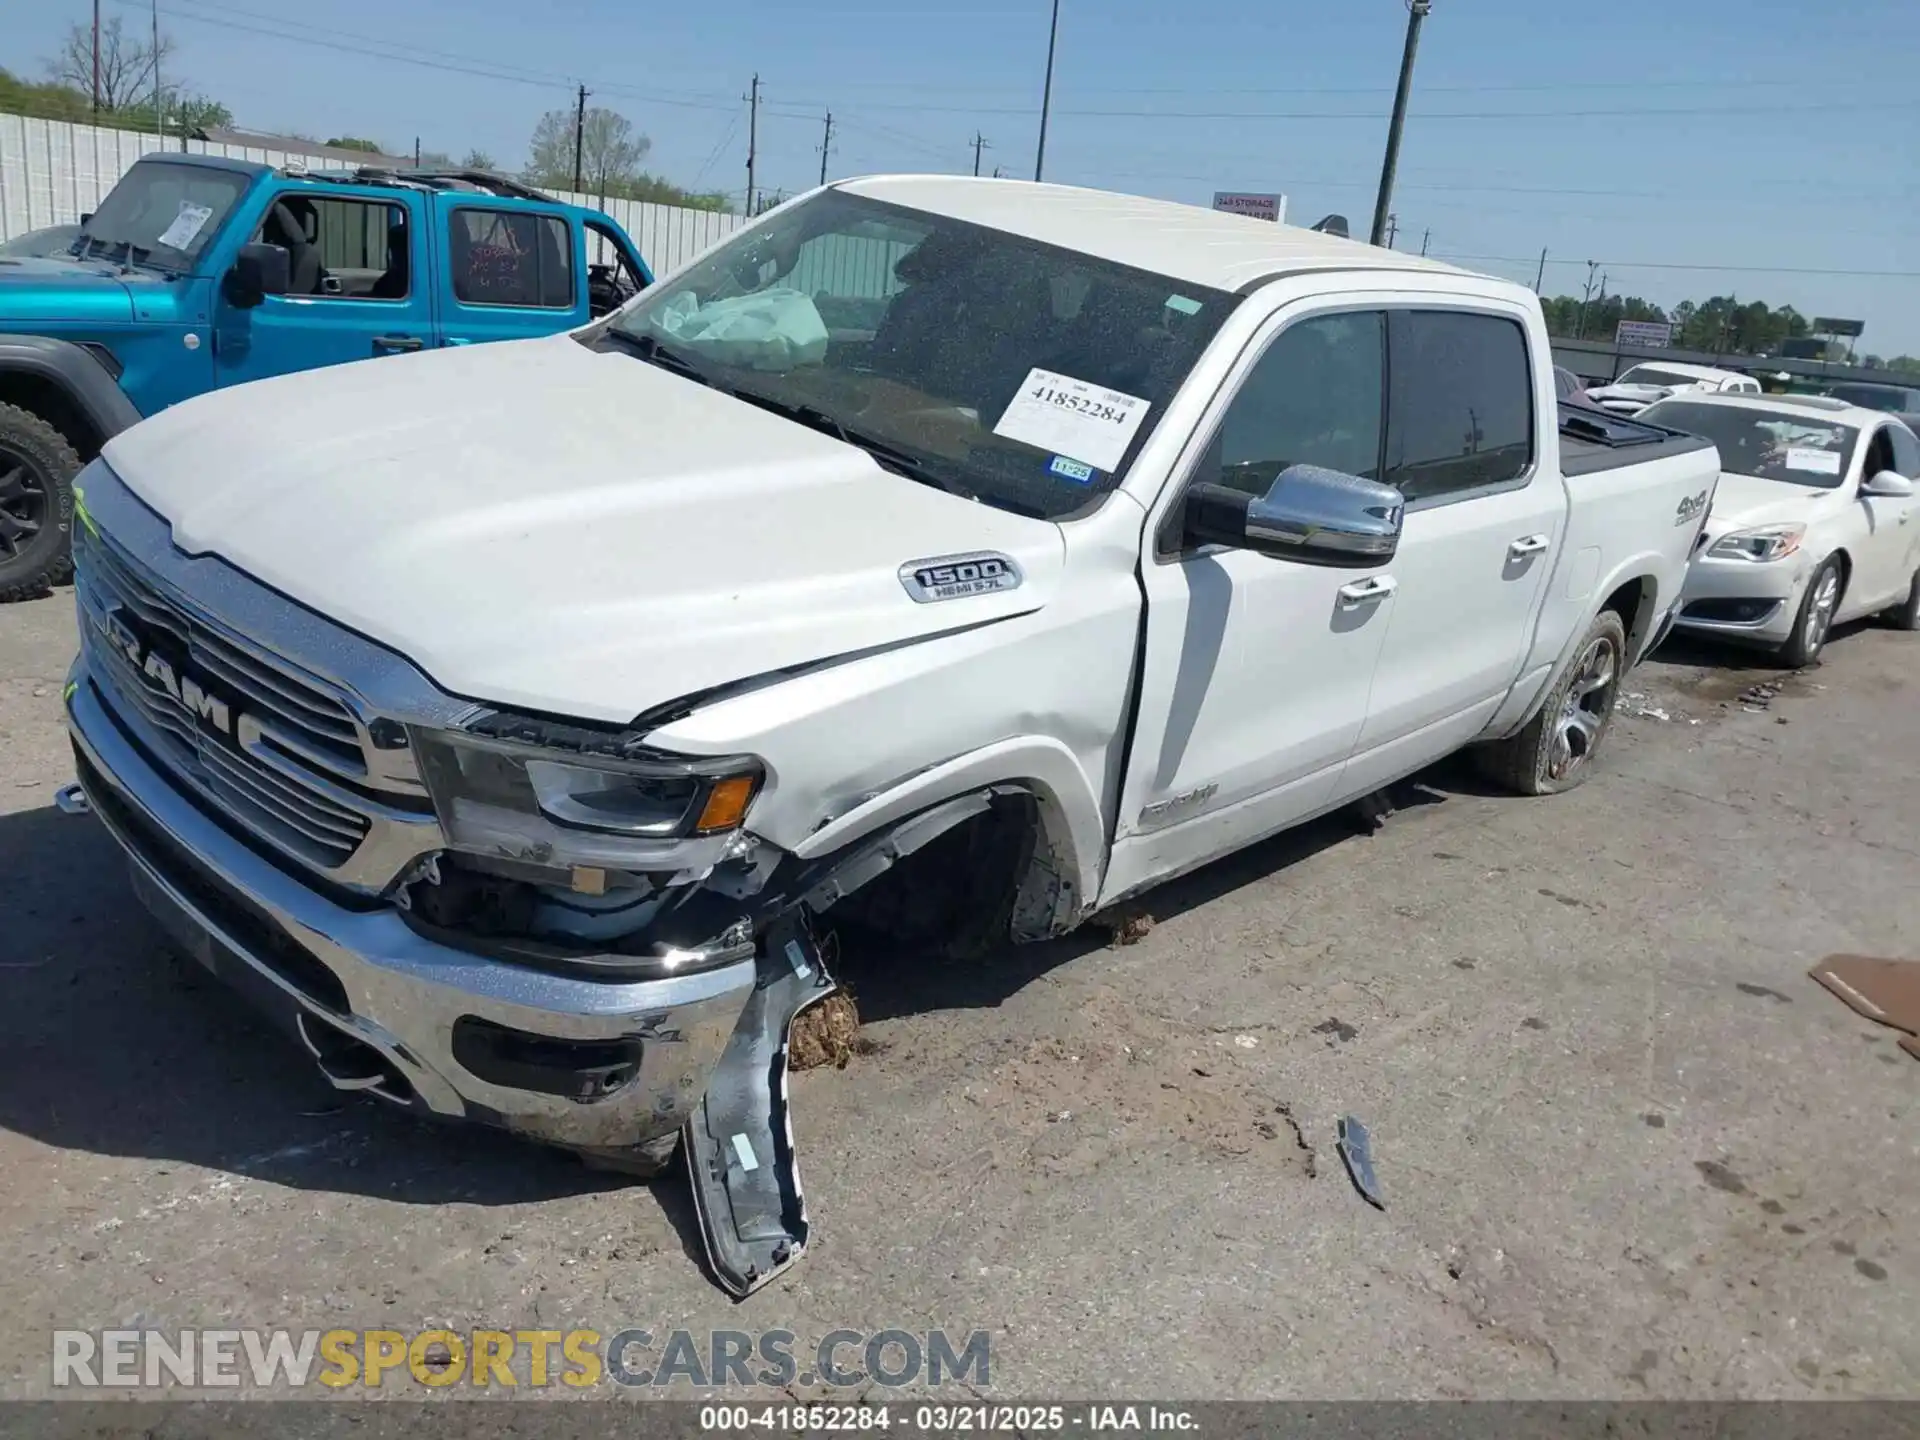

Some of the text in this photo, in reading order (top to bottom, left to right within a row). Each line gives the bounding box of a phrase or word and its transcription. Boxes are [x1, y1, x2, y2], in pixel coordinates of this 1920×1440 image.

[1031, 387, 1127, 424] 41852284
[914, 560, 1003, 588] 1500
[934, 584, 972, 597] HEMI
[106, 613, 230, 734] RAM
